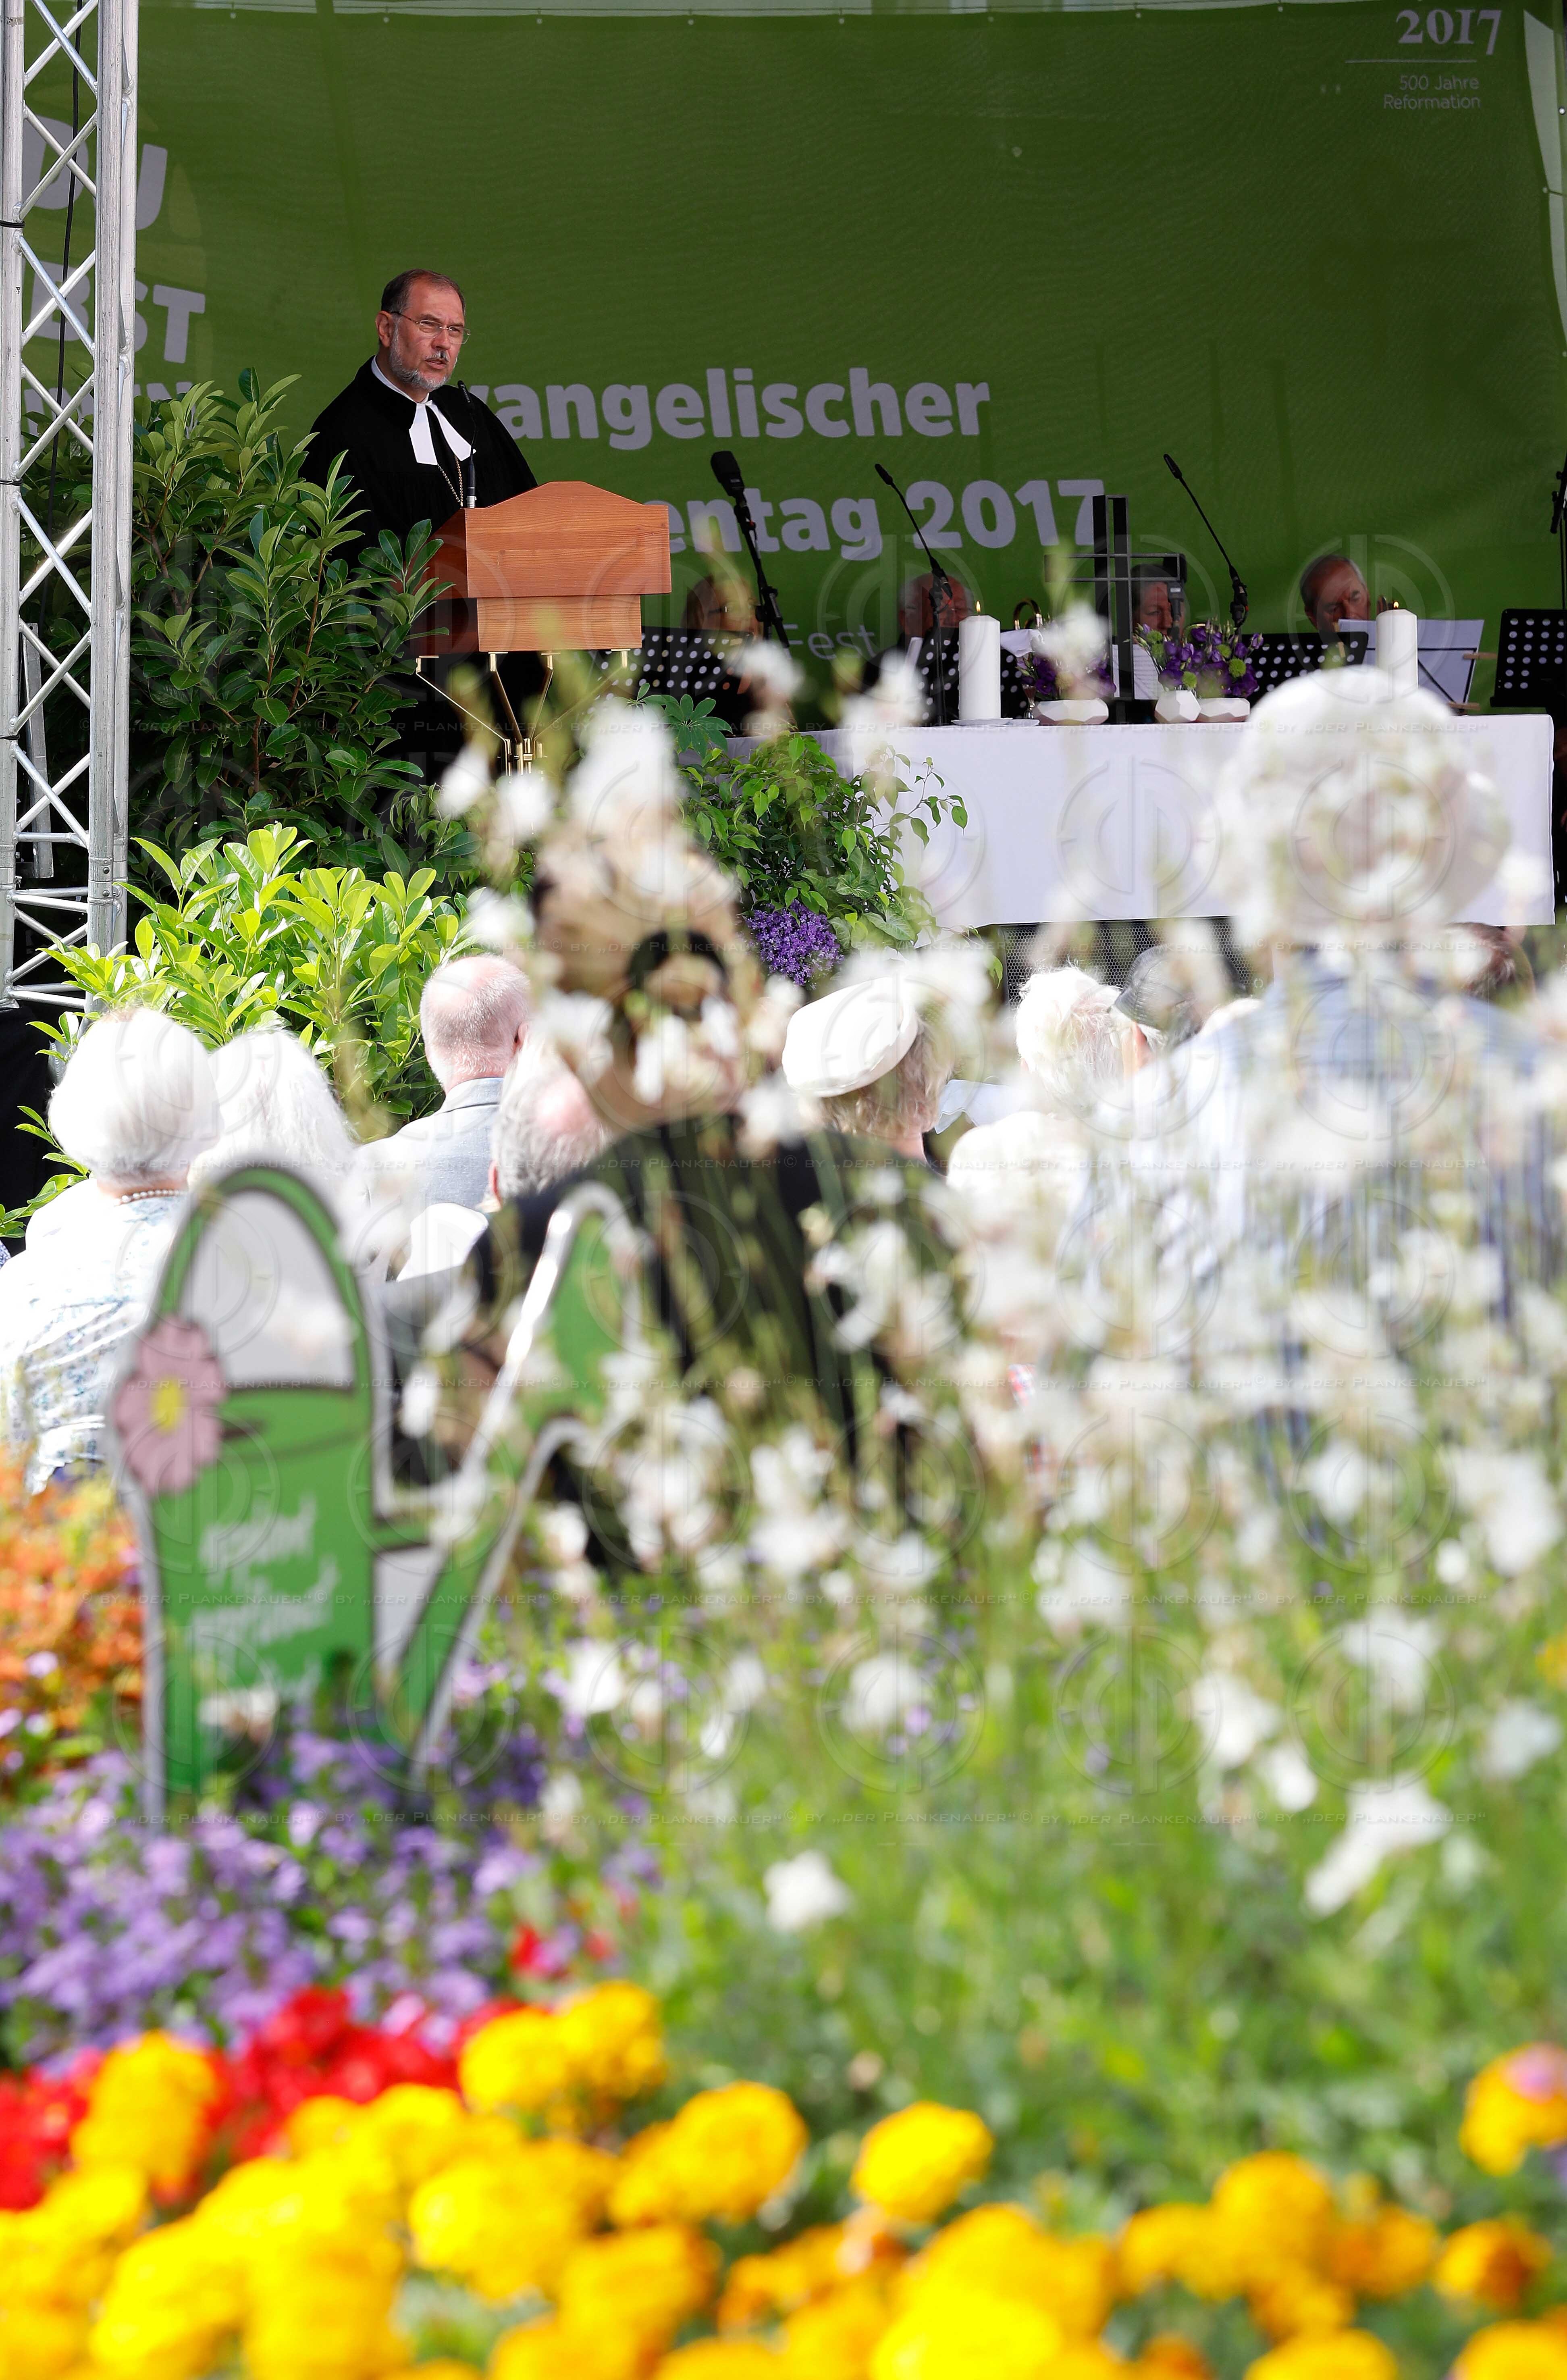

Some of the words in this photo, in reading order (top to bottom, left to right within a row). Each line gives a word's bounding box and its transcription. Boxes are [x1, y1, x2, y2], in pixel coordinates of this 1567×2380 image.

[1396, 8, 1503, 55] 2017
[1399, 75, 1429, 90] 500
[1434, 75, 1480, 90] Jahre
[1383, 94, 1482, 110] Reformation
[905, 479, 1105, 549] 2017
